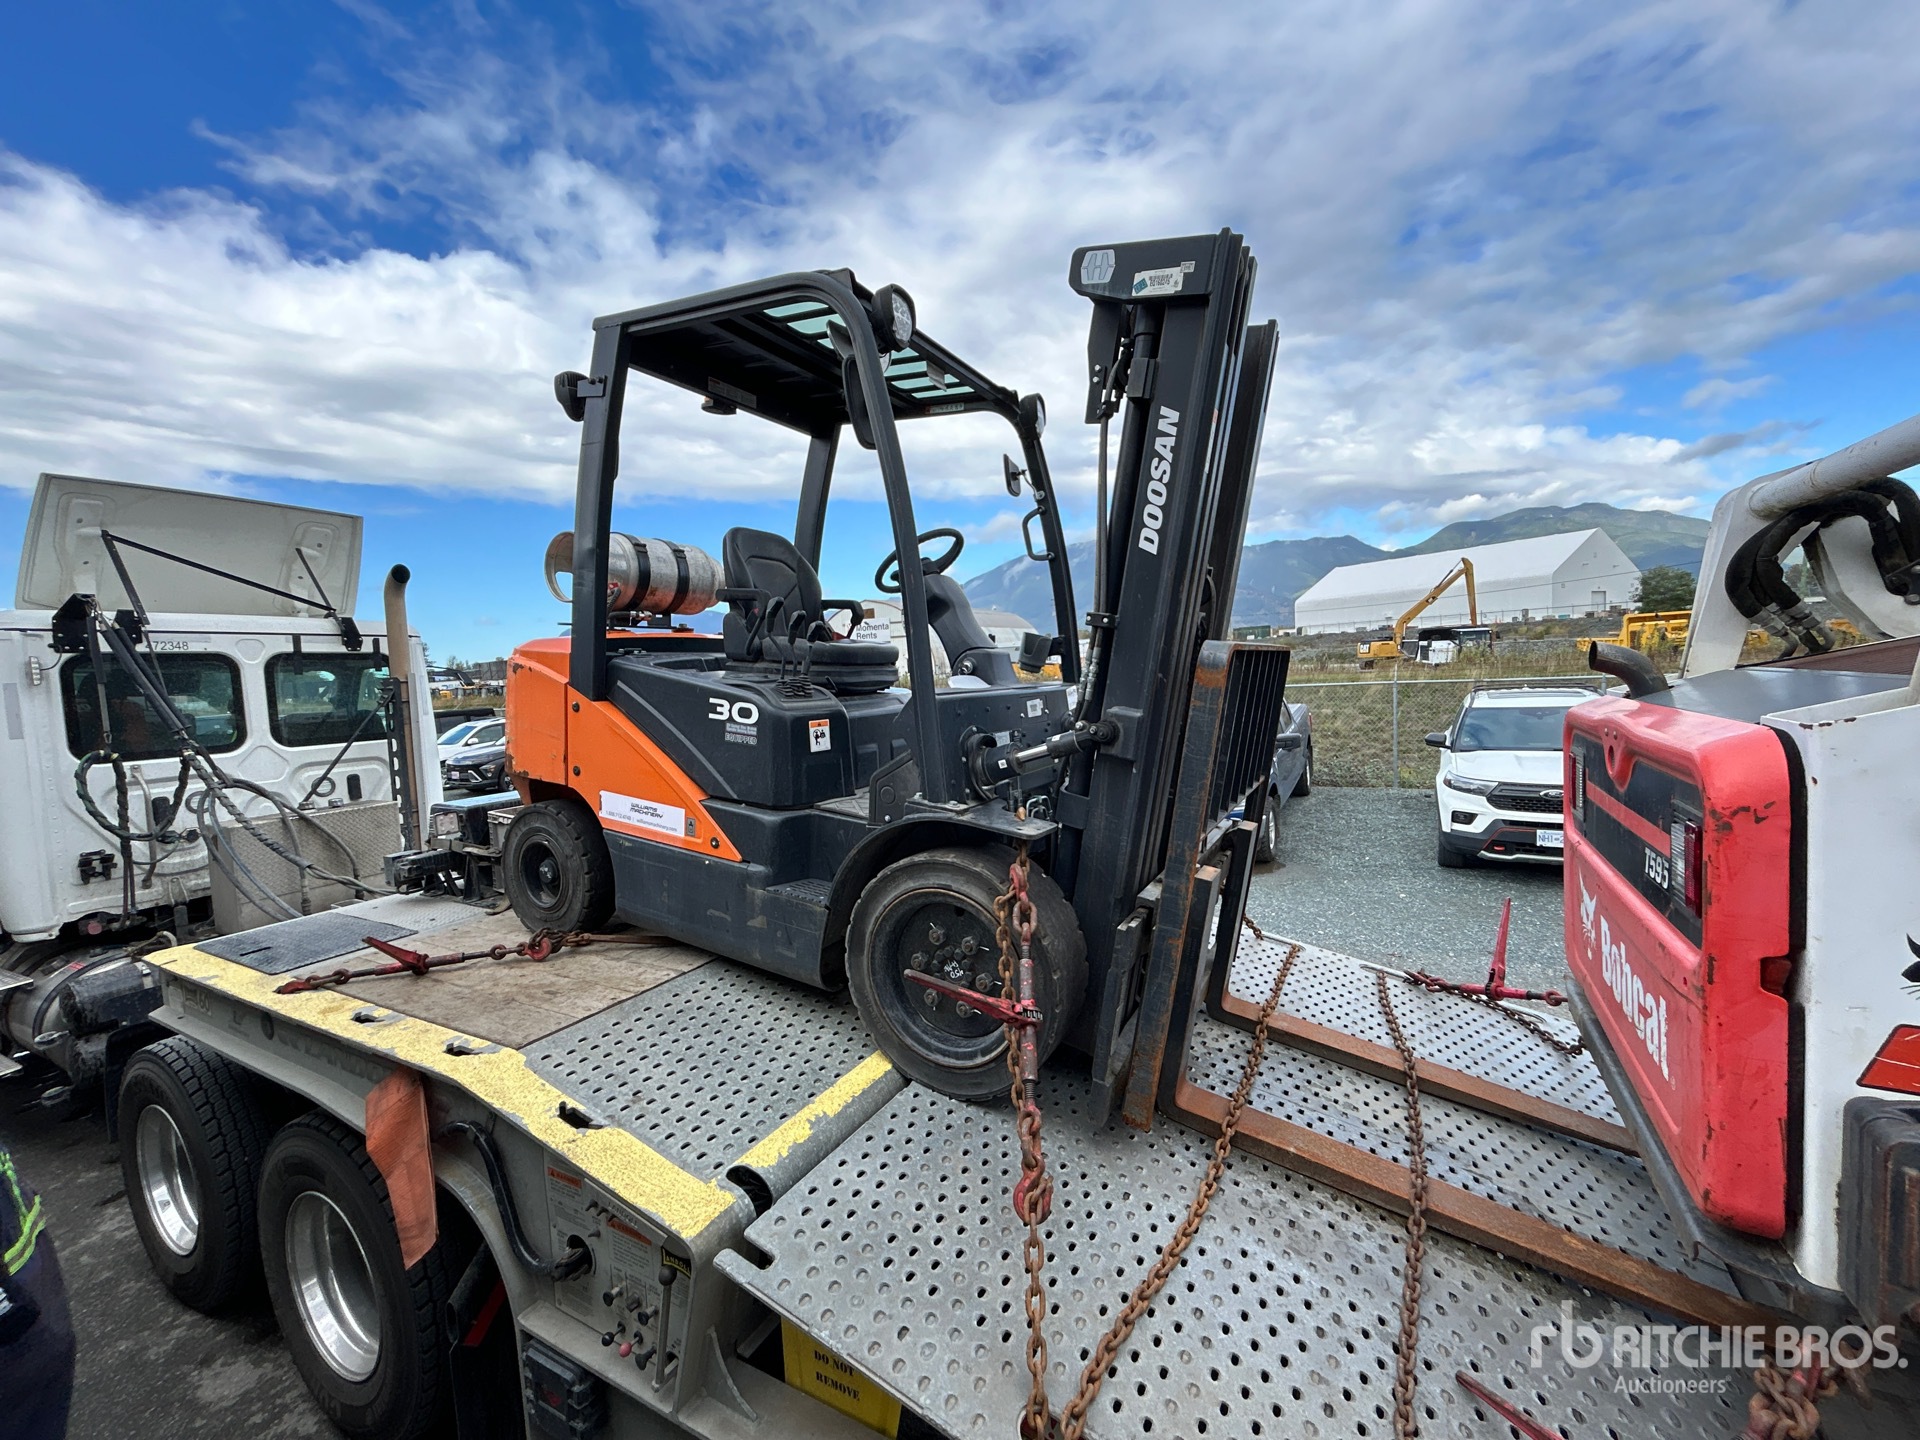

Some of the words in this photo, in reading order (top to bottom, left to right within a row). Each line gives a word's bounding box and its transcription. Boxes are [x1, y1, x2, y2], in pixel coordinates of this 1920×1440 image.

[1138, 406, 1180, 555] DOOSAN
[856, 632, 877, 640] Rents
[708, 697, 759, 725] 30
[630, 802, 658, 812] WILLIAMS
[630, 808, 663, 819] MACHINERY
[1645, 846, 1669, 889] T595
[1601, 914, 1669, 1082] Bobcat
[814, 1350, 829, 1365] DO
[833, 1358, 855, 1377] NOT
[816, 1371, 860, 1402] REMOVE
